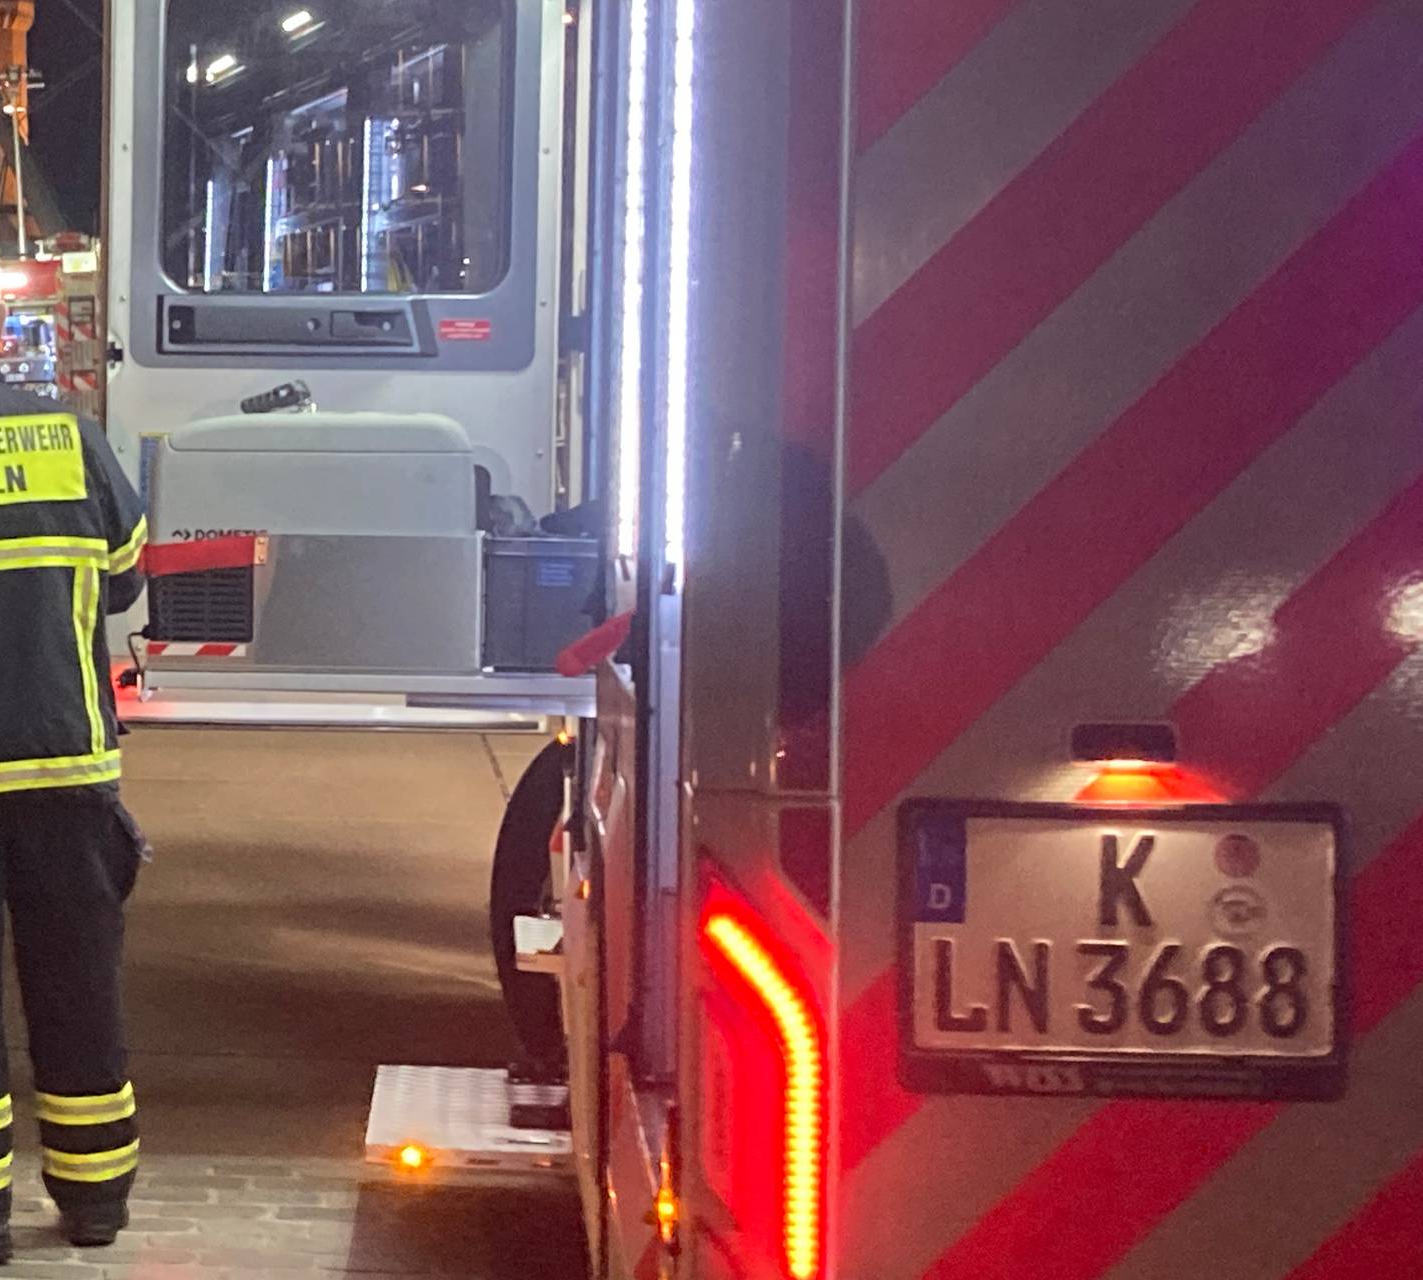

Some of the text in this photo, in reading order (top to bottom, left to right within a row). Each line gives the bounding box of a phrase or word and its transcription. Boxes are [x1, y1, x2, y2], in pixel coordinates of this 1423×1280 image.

[929, 882, 951, 909] D
[1098, 833, 1156, 927] K
[931, 938, 1309, 1038] LN 3688
